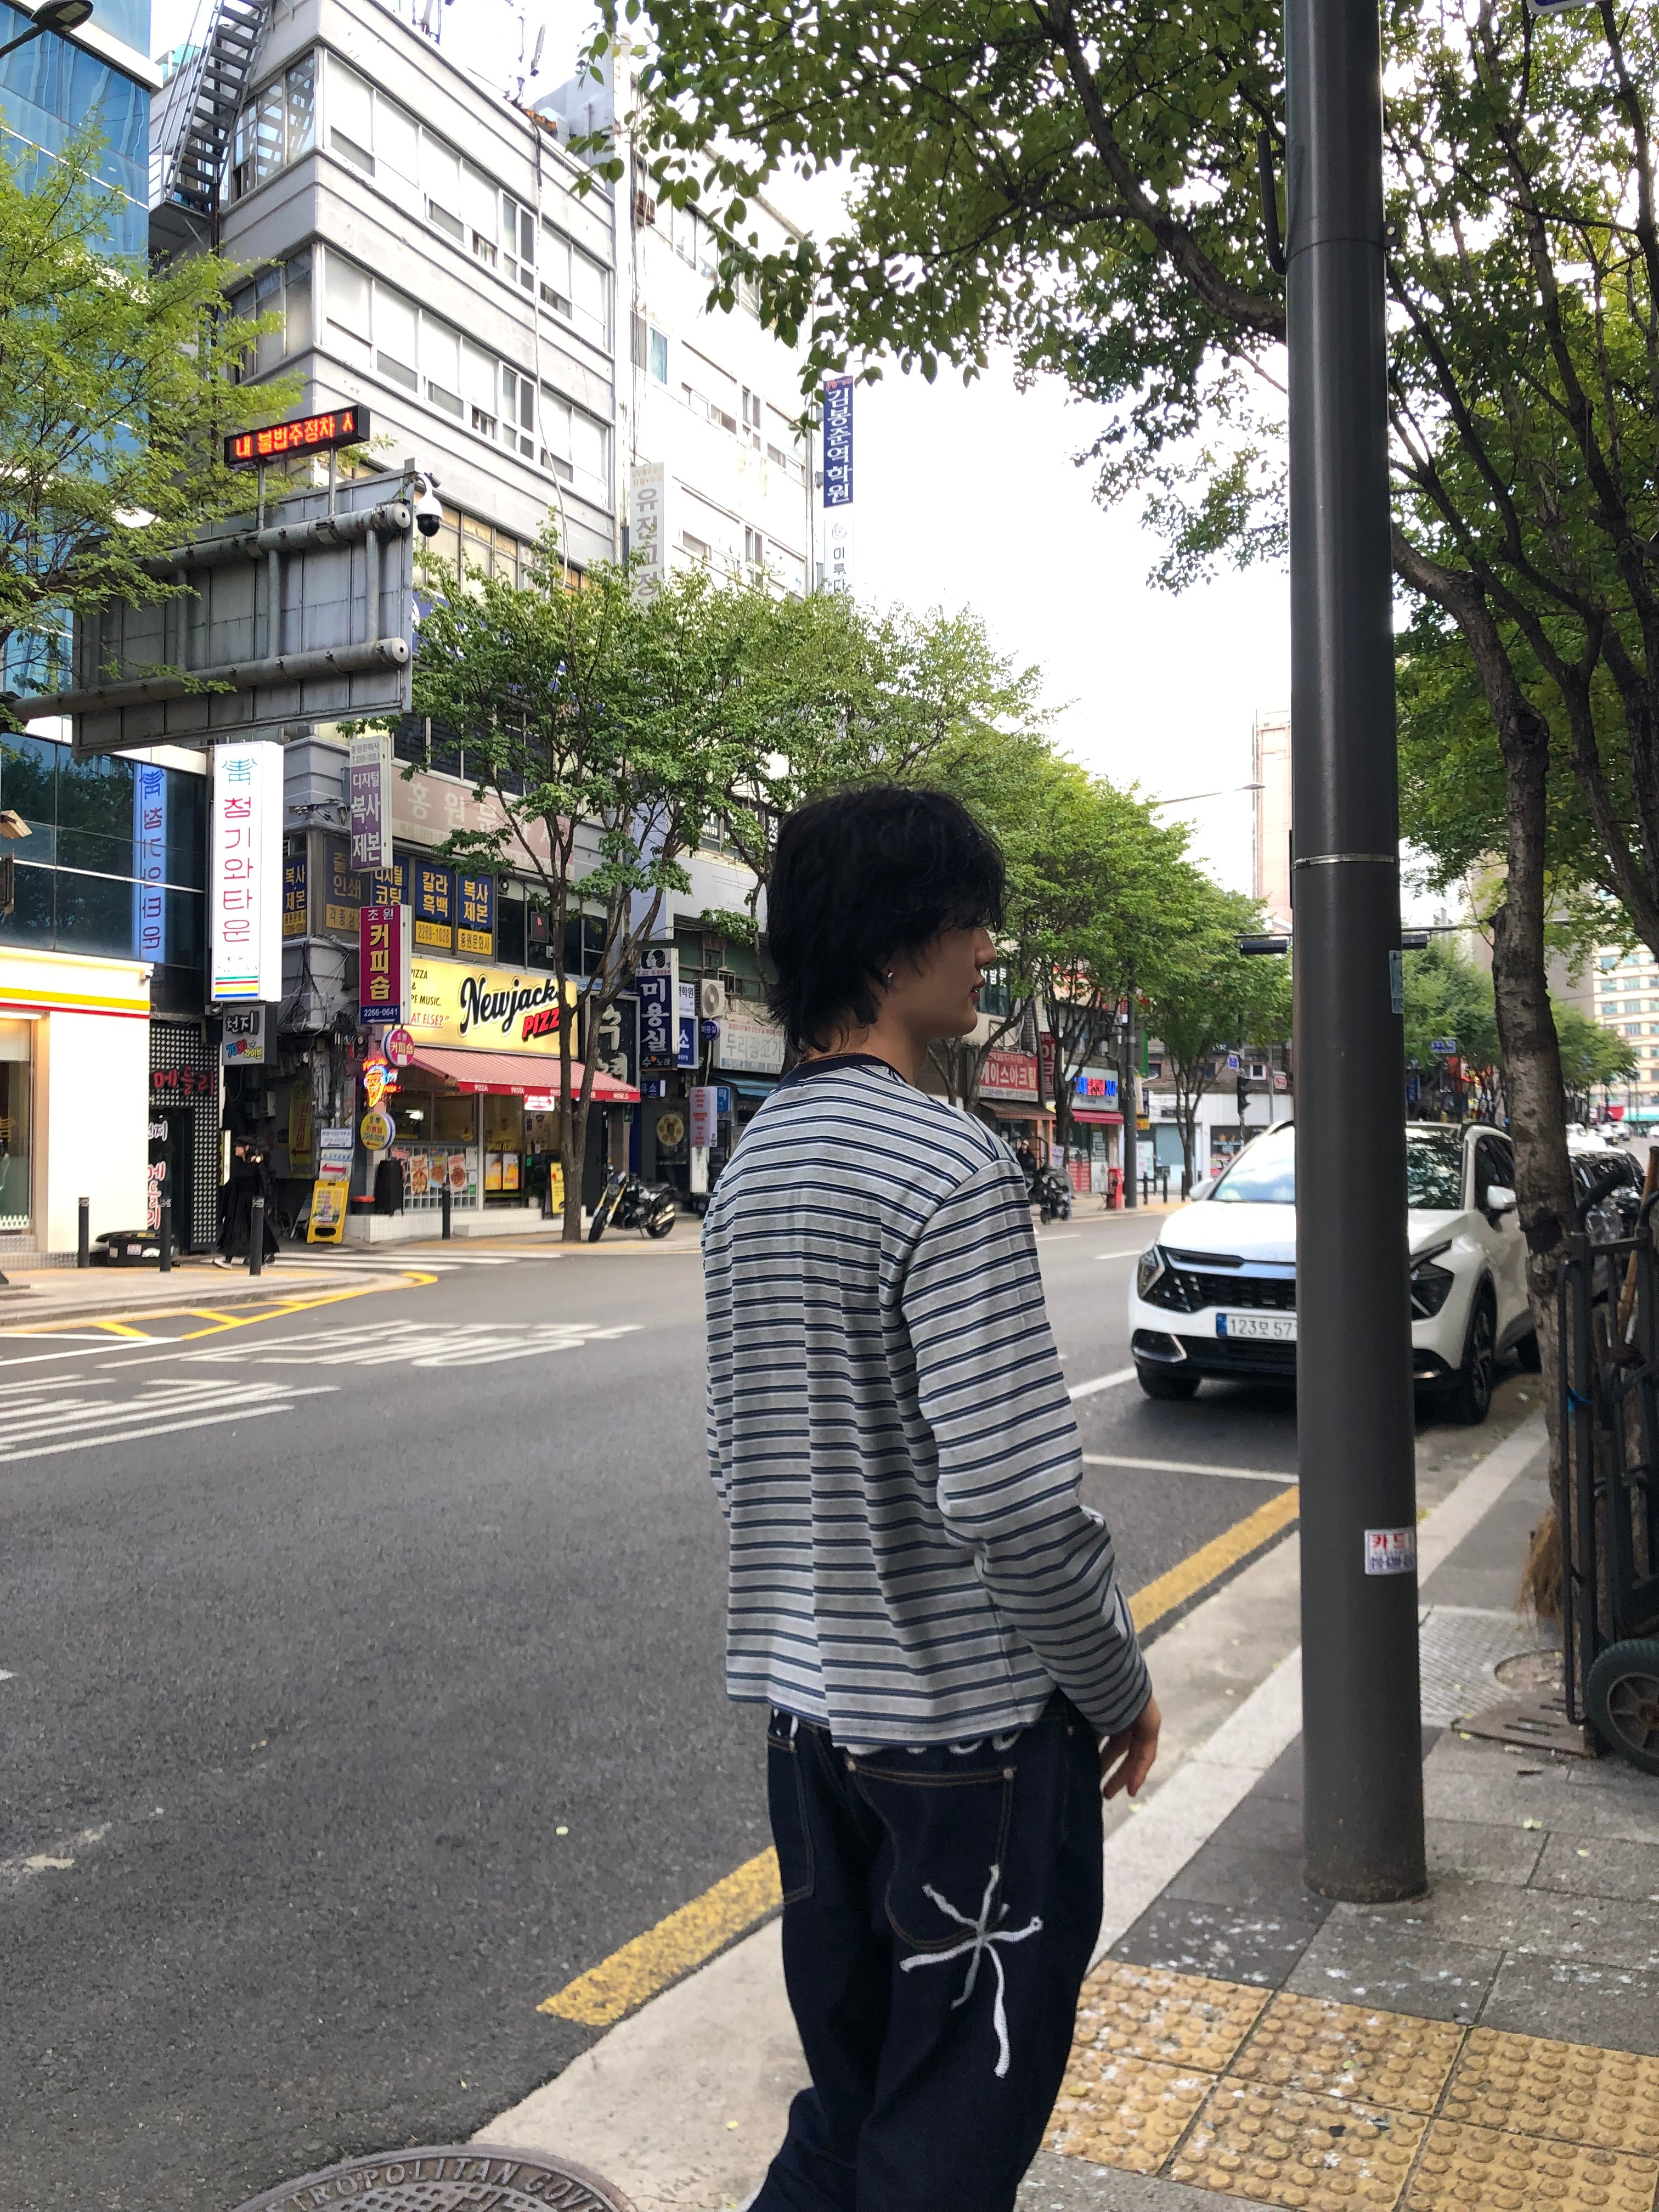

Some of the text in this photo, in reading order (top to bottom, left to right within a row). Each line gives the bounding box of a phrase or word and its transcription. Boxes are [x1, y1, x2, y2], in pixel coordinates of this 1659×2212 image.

[235, 435, 252, 458] 내
[258, 415, 335, 454] 불법주정차
[353, 770, 380, 789] 디지털
[352, 793, 380, 823] 복사
[353, 831, 381, 862] 제본
[222, 797, 253, 942] 청기와타운
[285, 864, 306, 885] 복사
[333, 874, 361, 900] 인쇄
[422, 871, 448, 895] 칼라
[464, 880, 488, 904] 복사
[285, 890, 306, 911] 제본
[423, 894, 448, 918] 흑백
[463, 900, 488, 923] 제본
[367, 907, 394, 921] 초원
[461, 933, 490, 952] 홍원문화사
[370, 924, 391, 1001] 커피숍
[522, 1007, 561, 1042] PIZZ
[640, 978, 670, 1052] 미용실
[154, 1066, 215, 1096] 메들리
[474, 1084, 488, 1092] PIZZA
[511, 1086, 524, 1095] PASTA
[1230, 1318, 1297, 1337] 123모 57
